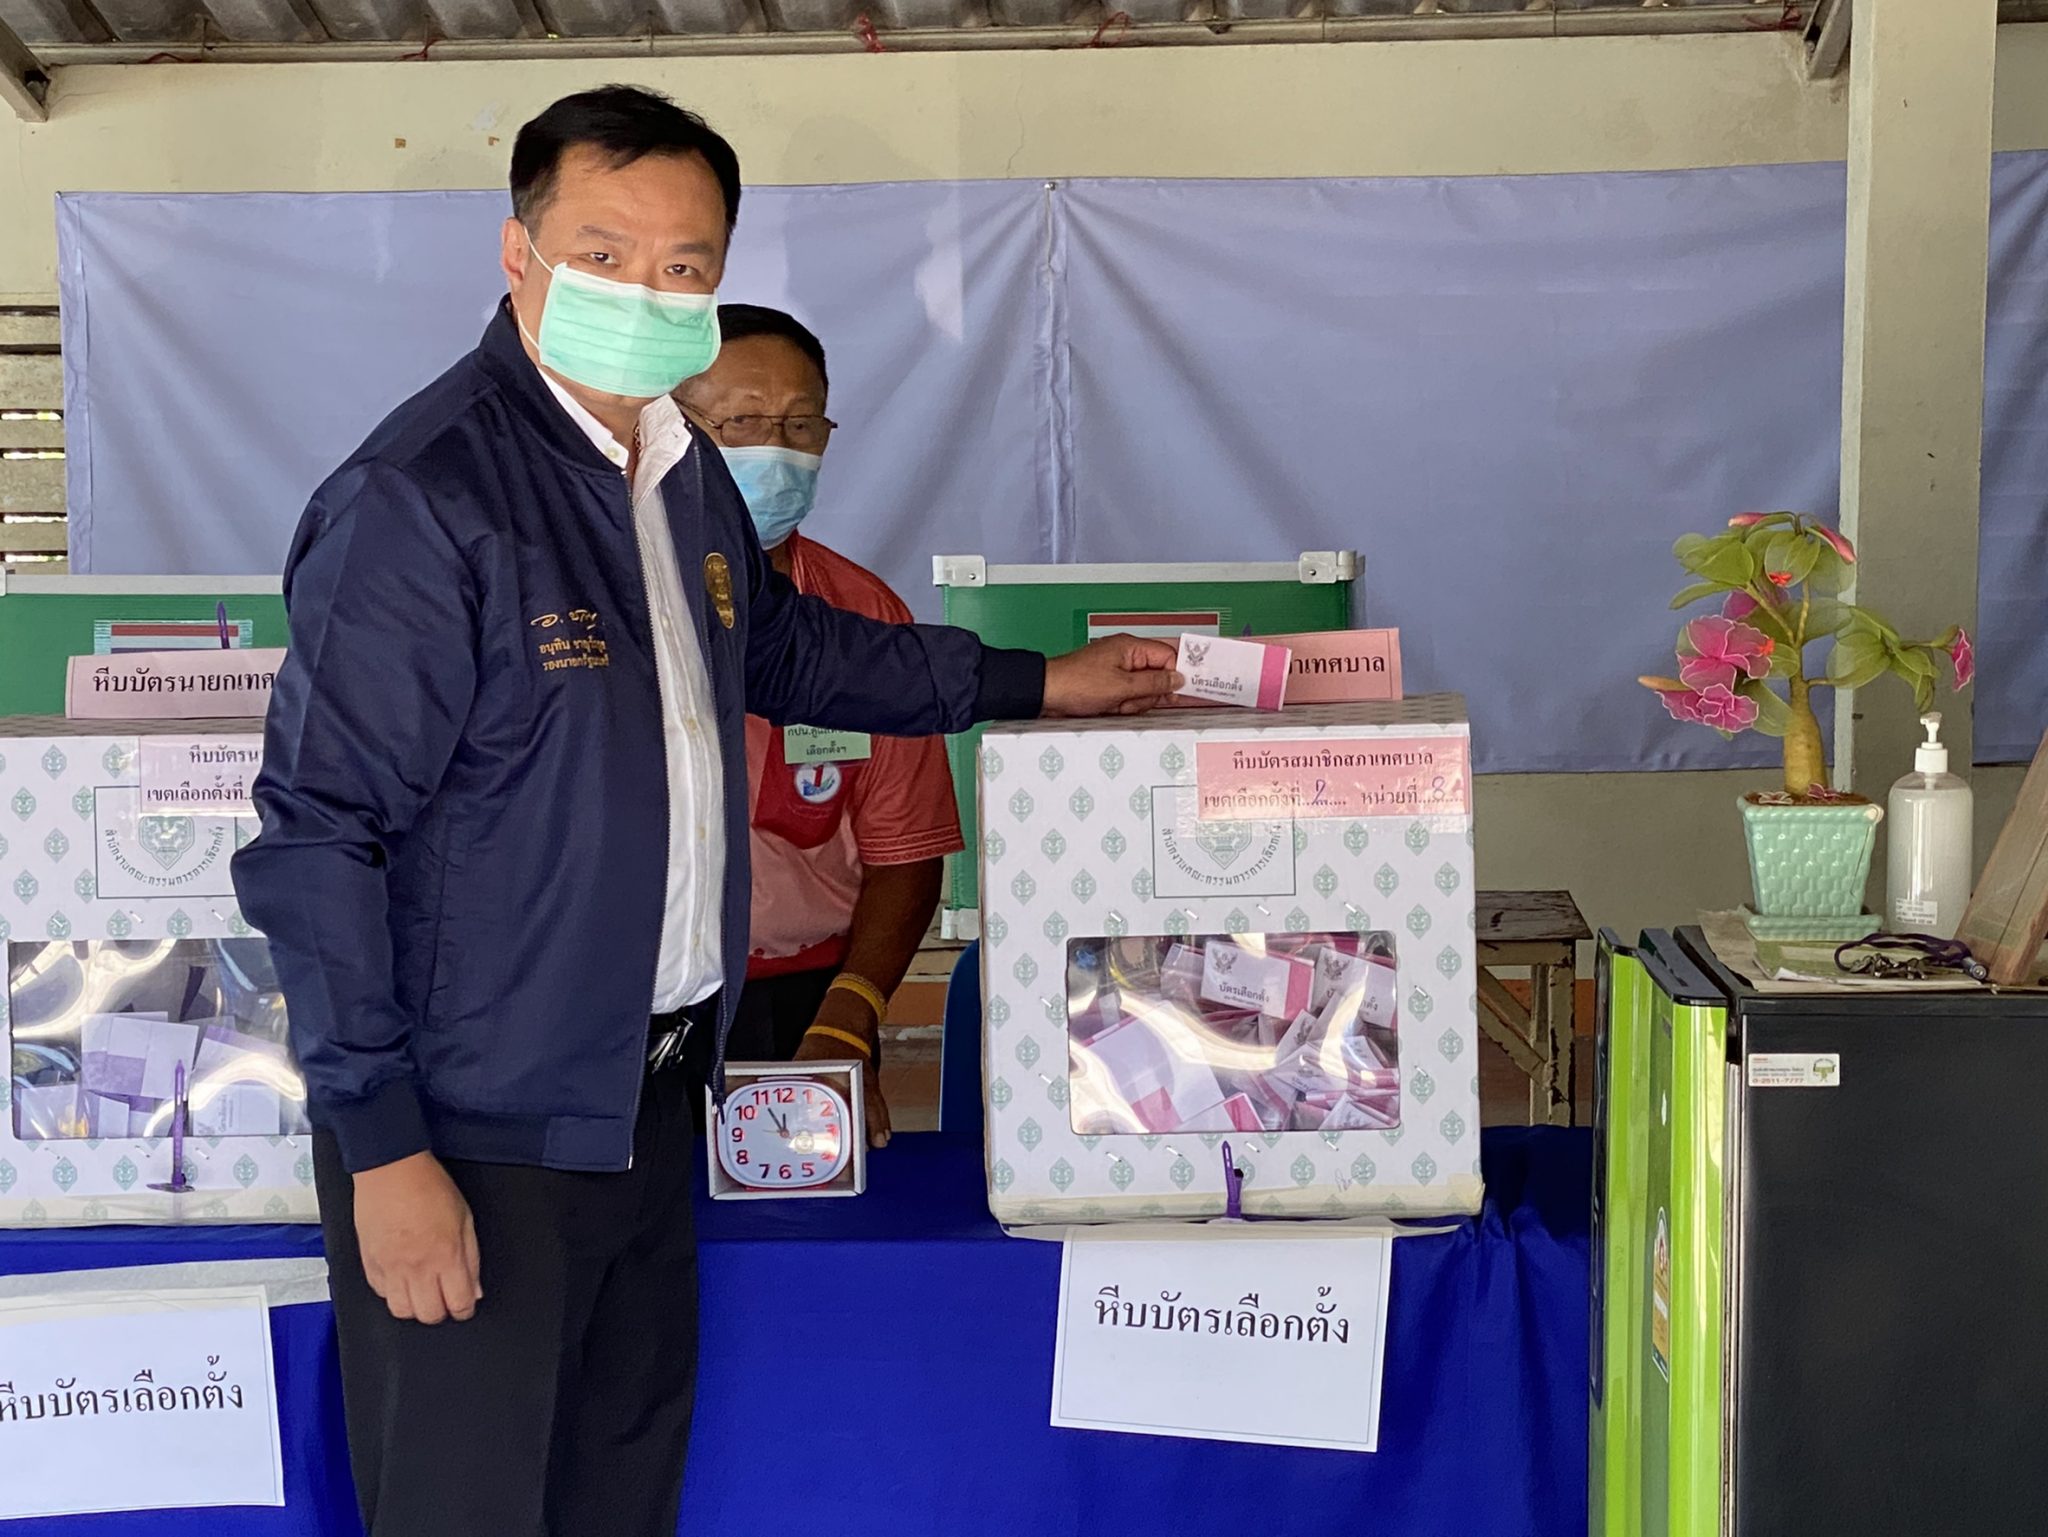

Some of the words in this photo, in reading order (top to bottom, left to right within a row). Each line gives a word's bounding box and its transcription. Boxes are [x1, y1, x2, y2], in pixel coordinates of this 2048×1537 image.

[539, 637, 571, 655] อนุทิน
[1289, 655, 1385, 675] าเทศบาล
[1191, 674, 1243, 692] บัตรเลือกตั้ง
[1232, 750, 1433, 770] หีบบัตรสมาชิกสภาเทศบาล
[1219, 981, 1270, 1003] บัตรเลือกตั้ง
[751, 1090, 769, 1105] 11
[773, 1087, 795, 1104] 12
[802, 1089, 814, 1105] 1
[735, 1105, 755, 1120] 10
[820, 1101, 834, 1117] 2
[732, 1127, 745, 1143] 9
[736, 1149, 749, 1165] 8
[758, 1164, 770, 1179] 7
[778, 1164, 792, 1179] 6
[801, 1162, 815, 1178] 5
[1093, 1284, 1350, 1344] หีบบัตรเลือกตั้ง
[0, 1355, 244, 1422] หีบบัตรเลือกตั้ง
